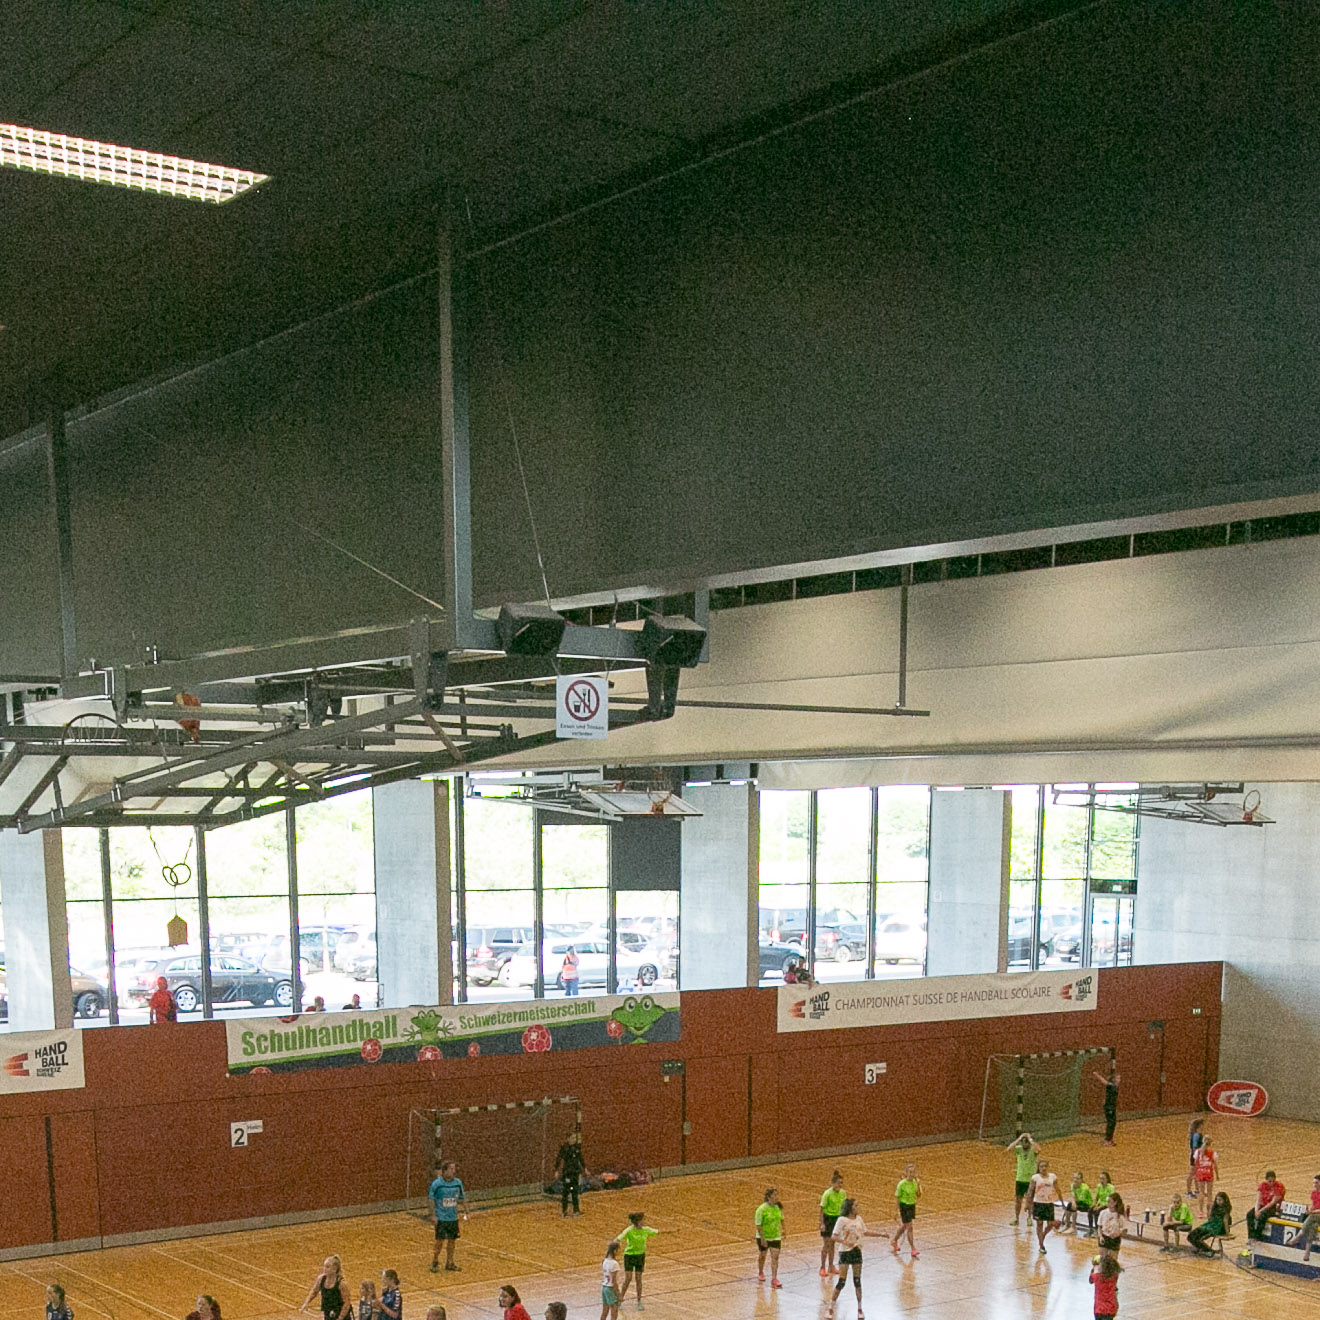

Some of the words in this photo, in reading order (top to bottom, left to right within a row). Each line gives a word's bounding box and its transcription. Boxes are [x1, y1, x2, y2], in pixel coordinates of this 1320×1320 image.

[809, 991, 830, 1005] HAND
[835, 994, 910, 1010] CHAMPIONNAT
[912, 992, 944, 1006] SUISSE
[946, 991, 958, 1004] DE
[960, 988, 1008, 1002] HANDBALL
[1011, 986, 1051, 998] SCOLAIRE
[241, 1015, 398, 1056] Schulhandball
[459, 1000, 596, 1030] Schweizermeisterschaft
[35, 1041, 68, 1059] HAND
[42, 1054, 69, 1068] BALL
[867, 1068, 874, 1083] 3
[234, 1127, 245, 1146] 2
